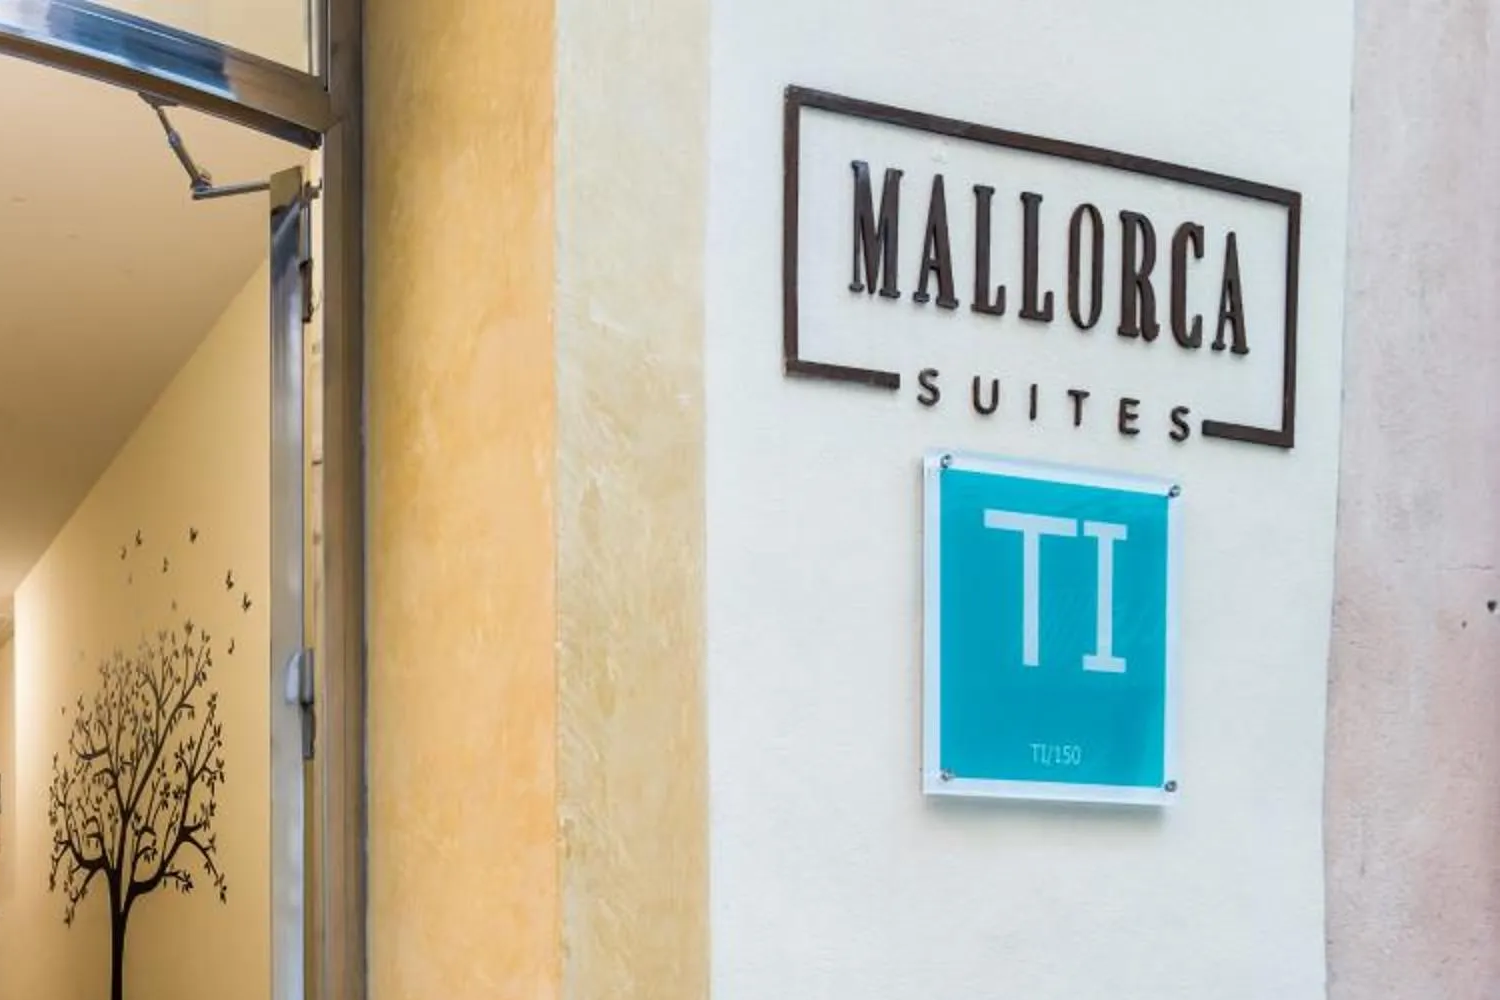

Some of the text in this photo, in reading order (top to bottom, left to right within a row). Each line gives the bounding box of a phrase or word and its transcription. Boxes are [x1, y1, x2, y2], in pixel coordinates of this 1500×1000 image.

[848, 159, 1250, 355] MALLORCA
[916, 367, 1192, 442] SUITES
[983, 507, 1128, 673] TI
[1029, 743, 1082, 766] TI/150
